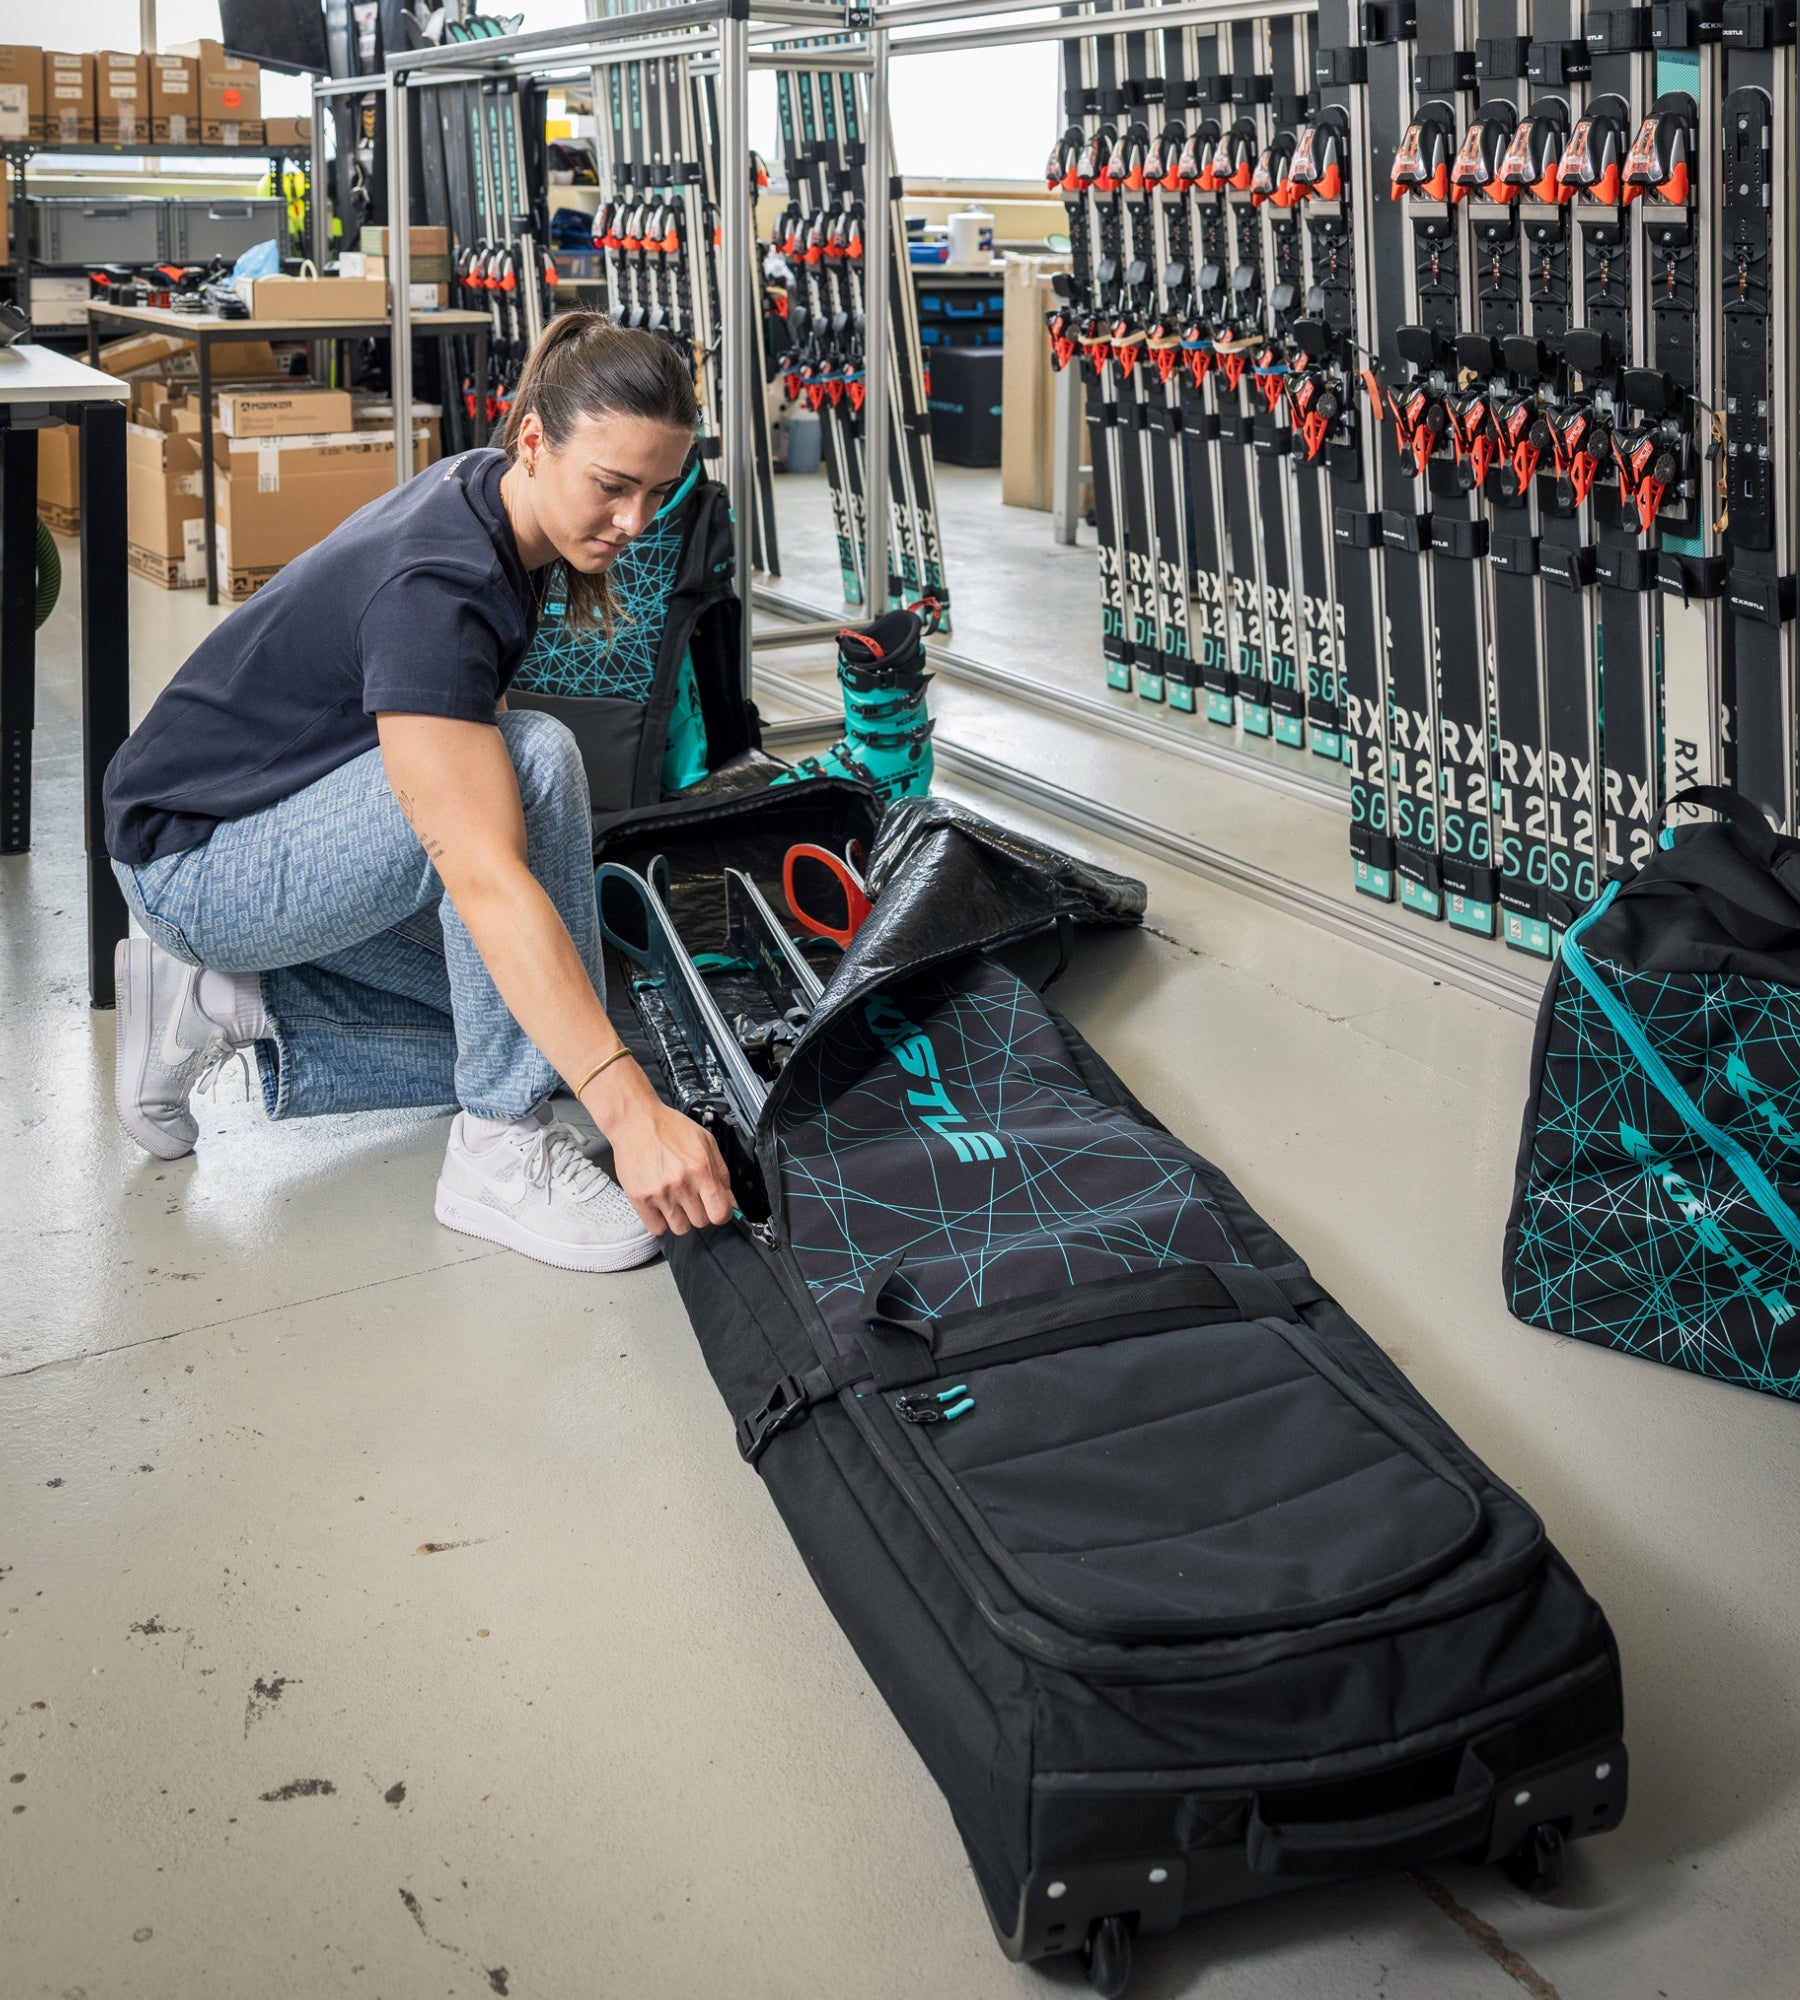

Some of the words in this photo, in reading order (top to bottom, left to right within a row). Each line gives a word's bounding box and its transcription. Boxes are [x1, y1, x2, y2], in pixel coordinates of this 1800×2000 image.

[1098, 545, 1120, 576] RX
[1129, 552, 1153, 584] RX
[1160, 560, 1183, 593] RX
[1101, 575, 1122, 609] 12
[1131, 584, 1155, 617] 12
[1197, 569, 1222, 603] RX
[1233, 576, 1258, 611] RX
[1266, 585, 1292, 621] RX
[1102, 608, 1123, 640] DH
[1161, 593, 1186, 627] 12
[1199, 603, 1225, 638] 12
[1303, 594, 1331, 631] RX
[1134, 617, 1158, 649] DH
[1164, 627, 1189, 660] DH
[1235, 611, 1261, 647] 12
[1267, 620, 1295, 657] 12
[1202, 637, 1227, 671] DH
[1238, 646, 1264, 681] DH
[1305, 630, 1334, 669] 12
[1270, 656, 1297, 692] DH
[1307, 666, 1335, 701] SG
[1346, 693, 1381, 742] RX
[1394, 705, 1431, 755] RX
[1442, 718, 1485, 768] RX
[1347, 738, 1384, 788] 12
[1393, 751, 1433, 802] 12
[1500, 739, 1544, 792] RX
[1549, 750, 1592, 806] RX
[1351, 784, 1386, 830] SG
[1442, 766, 1487, 817] 12
[1605, 767, 1649, 825] RX
[1398, 798, 1435, 845] SG
[1501, 787, 1546, 840] 12
[1549, 800, 1594, 856] 12
[1445, 814, 1489, 861] SG
[1605, 818, 1653, 873] 12
[1502, 836, 1547, 886] SG
[1550, 851, 1595, 902] SG
